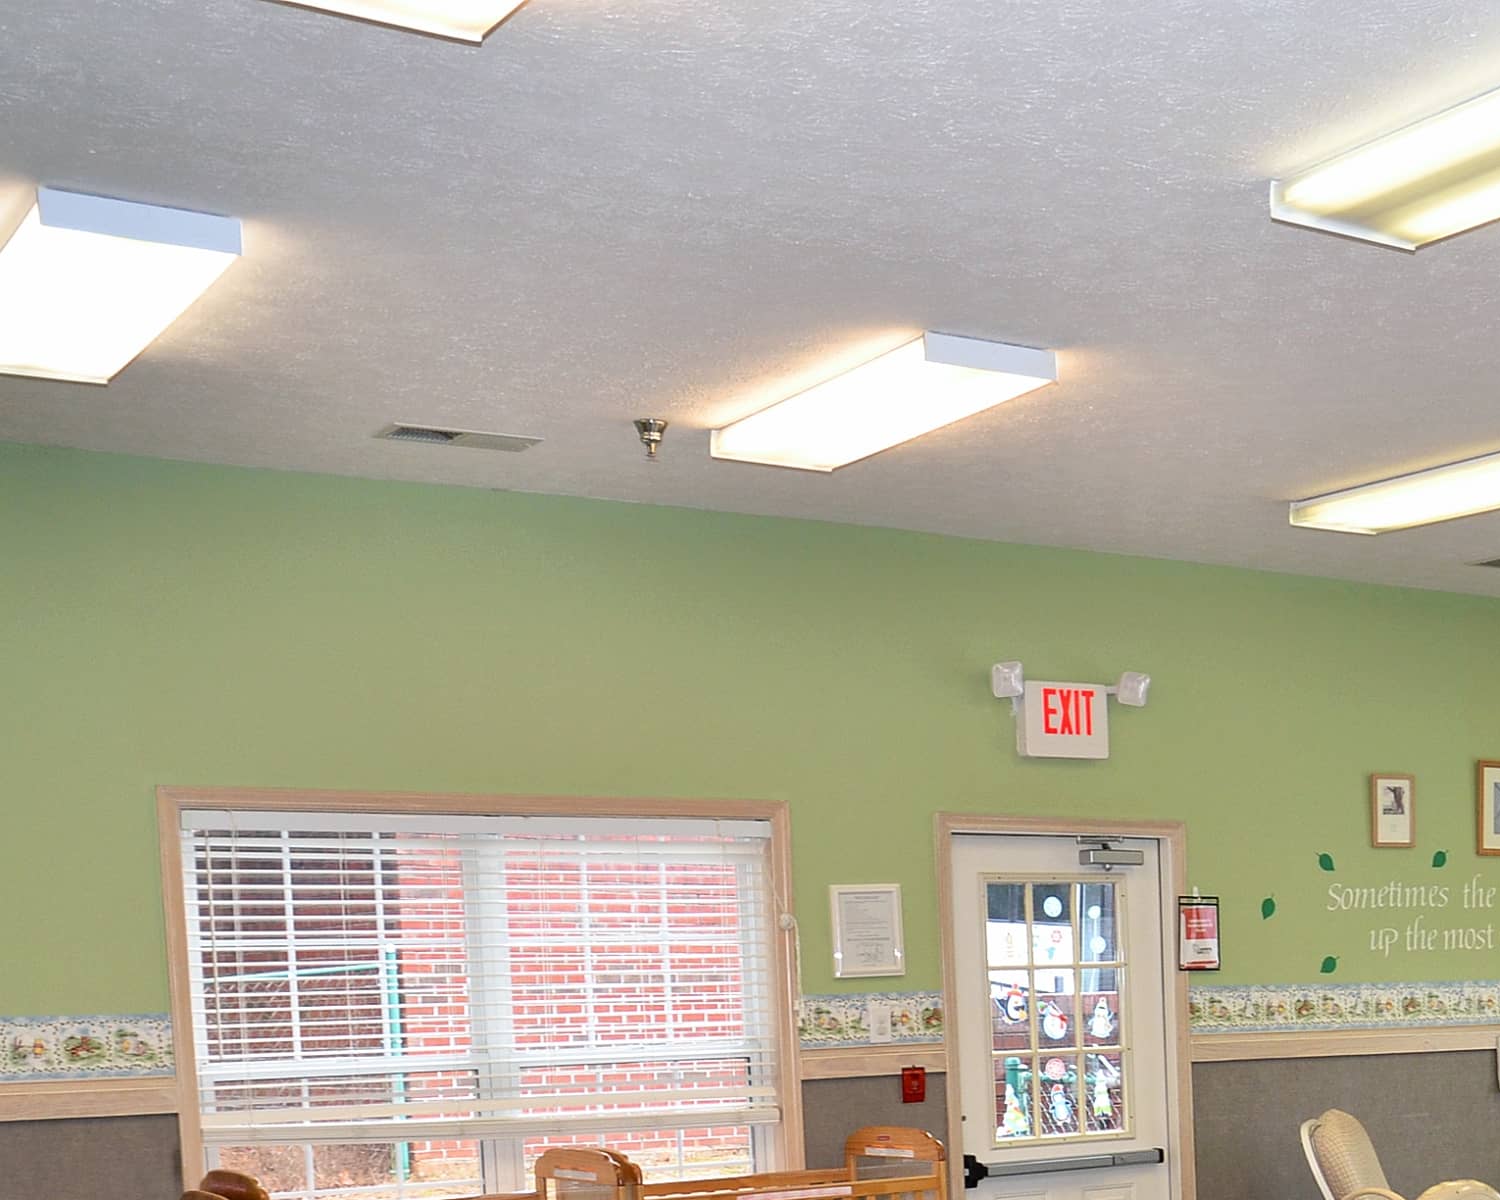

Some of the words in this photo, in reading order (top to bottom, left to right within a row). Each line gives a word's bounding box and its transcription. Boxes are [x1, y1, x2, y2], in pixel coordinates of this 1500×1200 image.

[1042, 687, 1095, 736] EXIT
[1327, 881, 1449, 911] Sometimes
[1463, 873, 1497, 909] the
[1369, 927, 1399, 958] up
[1405, 915, 1438, 951] the
[1443, 923, 1494, 950] most
